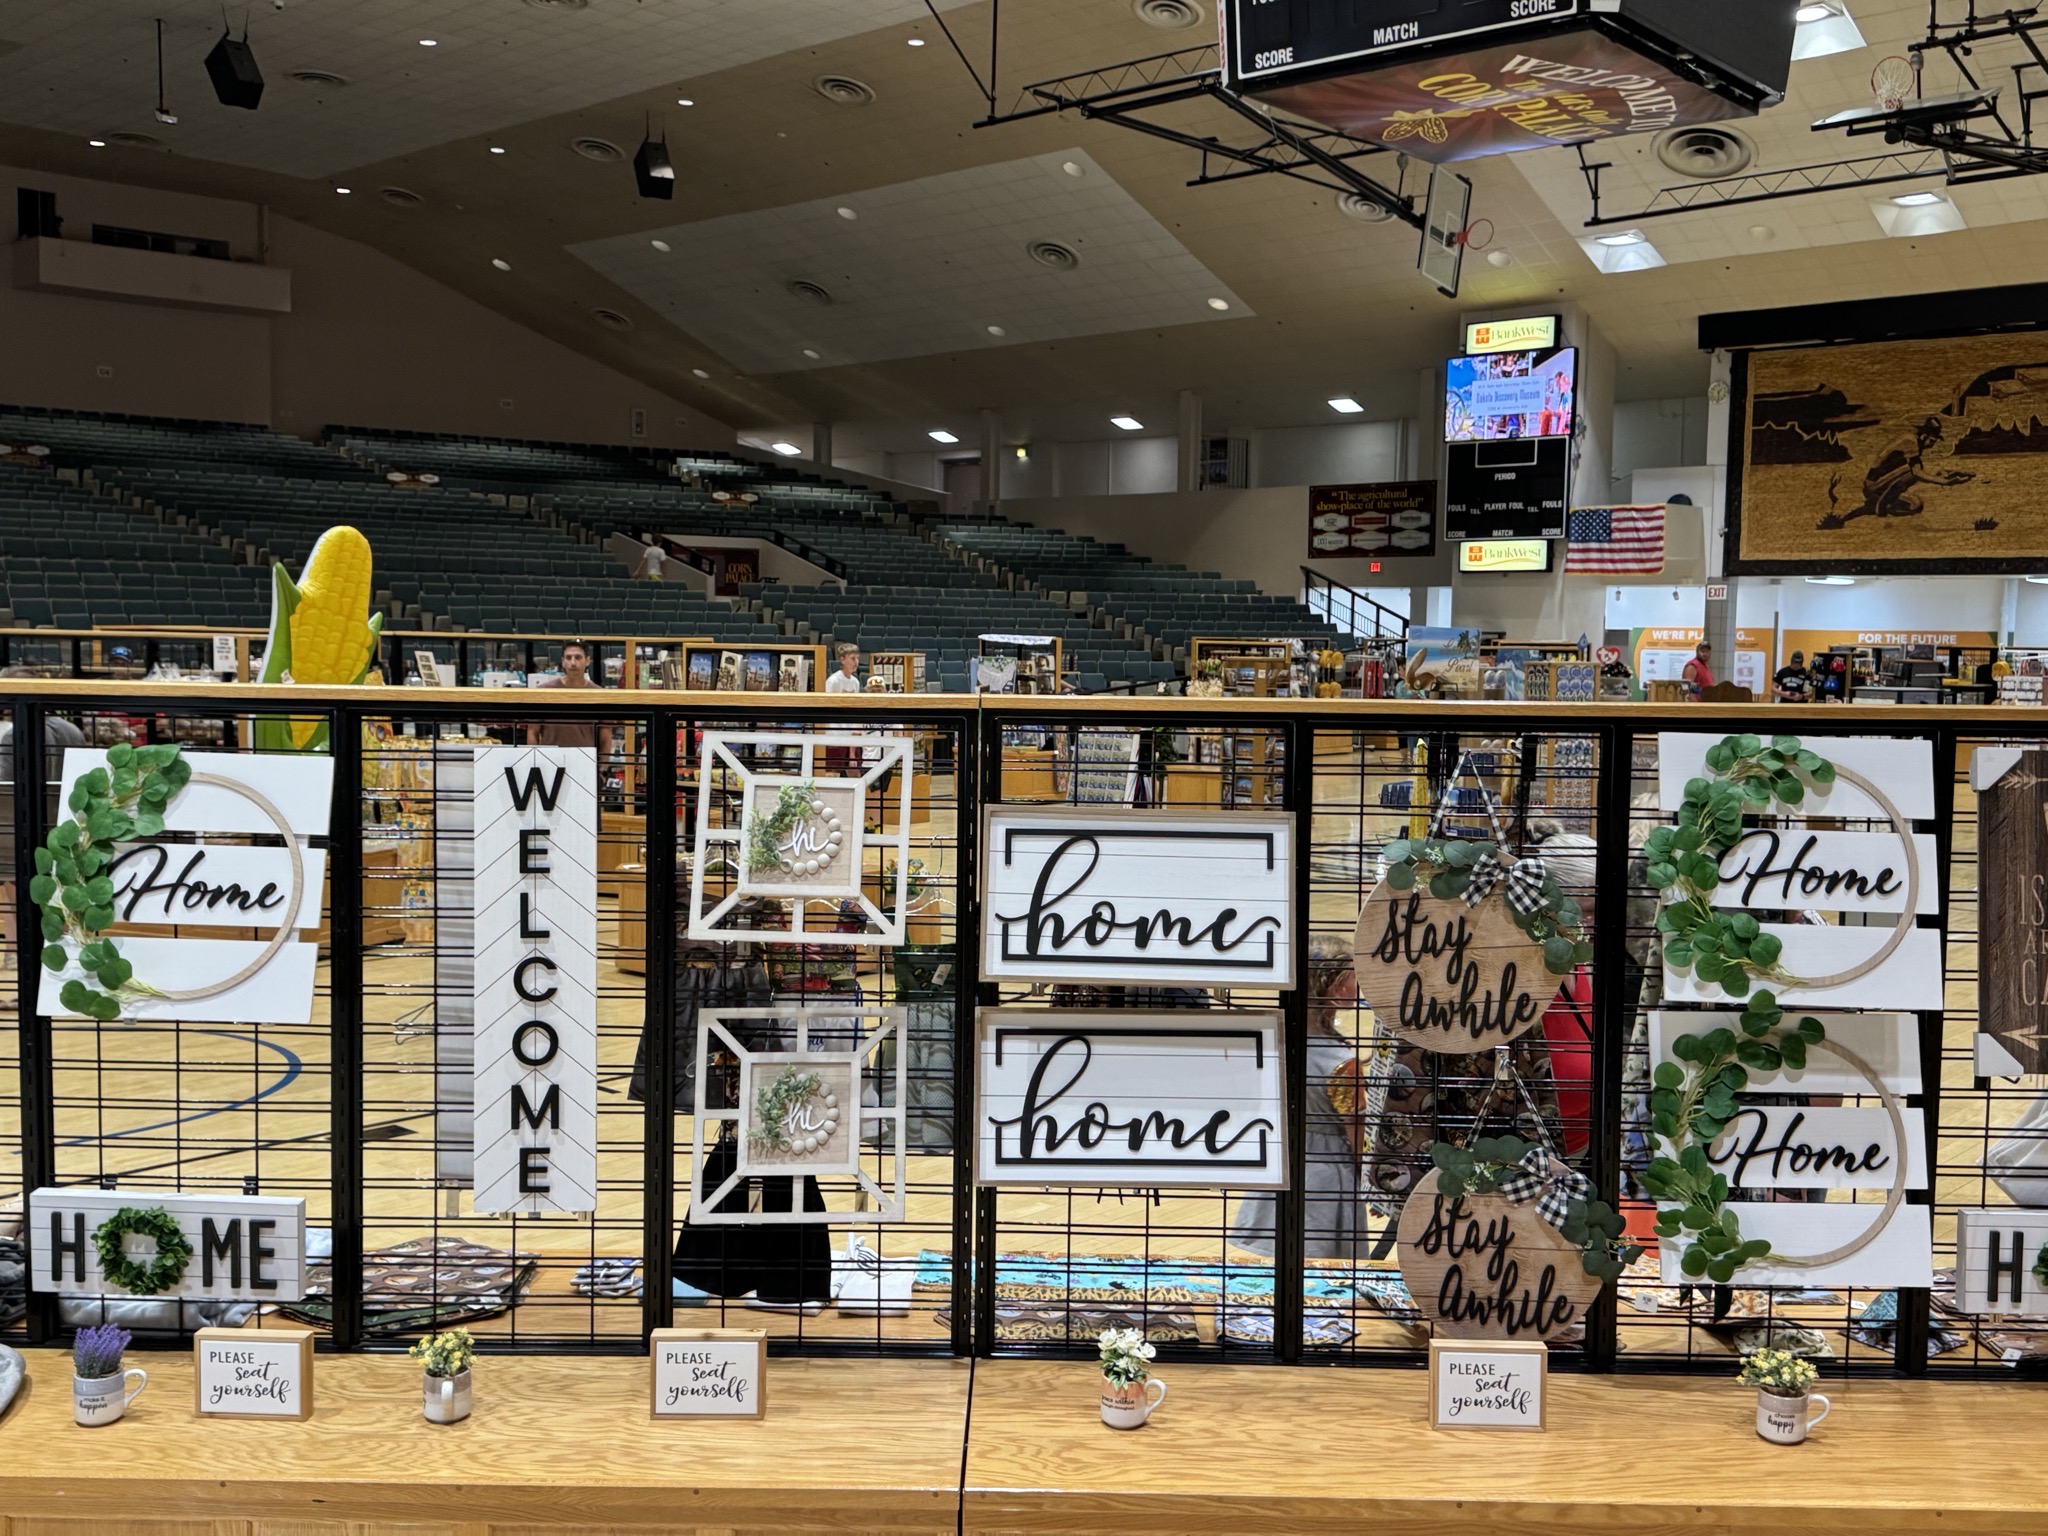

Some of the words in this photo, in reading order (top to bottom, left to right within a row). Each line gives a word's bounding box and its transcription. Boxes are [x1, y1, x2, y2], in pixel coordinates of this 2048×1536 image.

[1509, 0, 1557, 18] SCORE
[1373, 21, 1419, 46] MATCH
[1254, 47, 1294, 70] SCORE
[1500, 54, 1677, 116] WELCOME
[1626, 113, 1678, 131] TO
[1491, 325, 1549, 340] BankWest
[1494, 472, 1516, 481] PERIOD
[1358, 488, 1408, 503] agricultural
[1316, 501, 1364, 513] show-place
[1366, 500, 1375, 509] of
[1377, 499, 1394, 509] the
[1448, 504, 1467, 512] FOULS
[1484, 503, 1507, 511] PLAYER
[1508, 502, 1525, 510] FOUL
[1542, 500, 1563, 508] FOULS
[1492, 529, 1514, 537] MATCH
[1541, 528, 1562, 536] SCORE
[1484, 547, 1542, 559] BankWest
[725, 573, 757, 584] PALACE
[728, 563, 753, 574] CORN
[1708, 587, 1726, 598] EXIT
[1652, 630, 1686, 640] WE'RE
[1857, 633, 1883, 644] FOR
[1885, 633, 1908, 644] THE
[1910, 633, 1957, 645] FUTURE
[779, 819, 830, 857] hi
[1717, 830, 1903, 906] Home
[108, 844, 285, 922] Home
[995, 835, 1281, 956] home
[2019, 874, 2045, 926] IS
[504, 766, 566, 1193] WELCOME
[988, 1036, 1274, 1159] home
[781, 1101, 827, 1134] hi
[1705, 1109, 1890, 1187] Home
[209, 1351, 255, 1364] PLEASE
[666, 1352, 712, 1365] PLEASE
[235, 1361, 279, 1381] seat
[692, 1360, 737, 1382] seat
[1449, 1362, 1496, 1376] PLEASE
[209, 1377, 291, 1405] yourself
[665, 1376, 749, 1406] yourself
[1475, 1372, 1521, 1393] seat
[1448, 1388, 1533, 1417] yourself
[1767, 1414, 1795, 1434] happy
